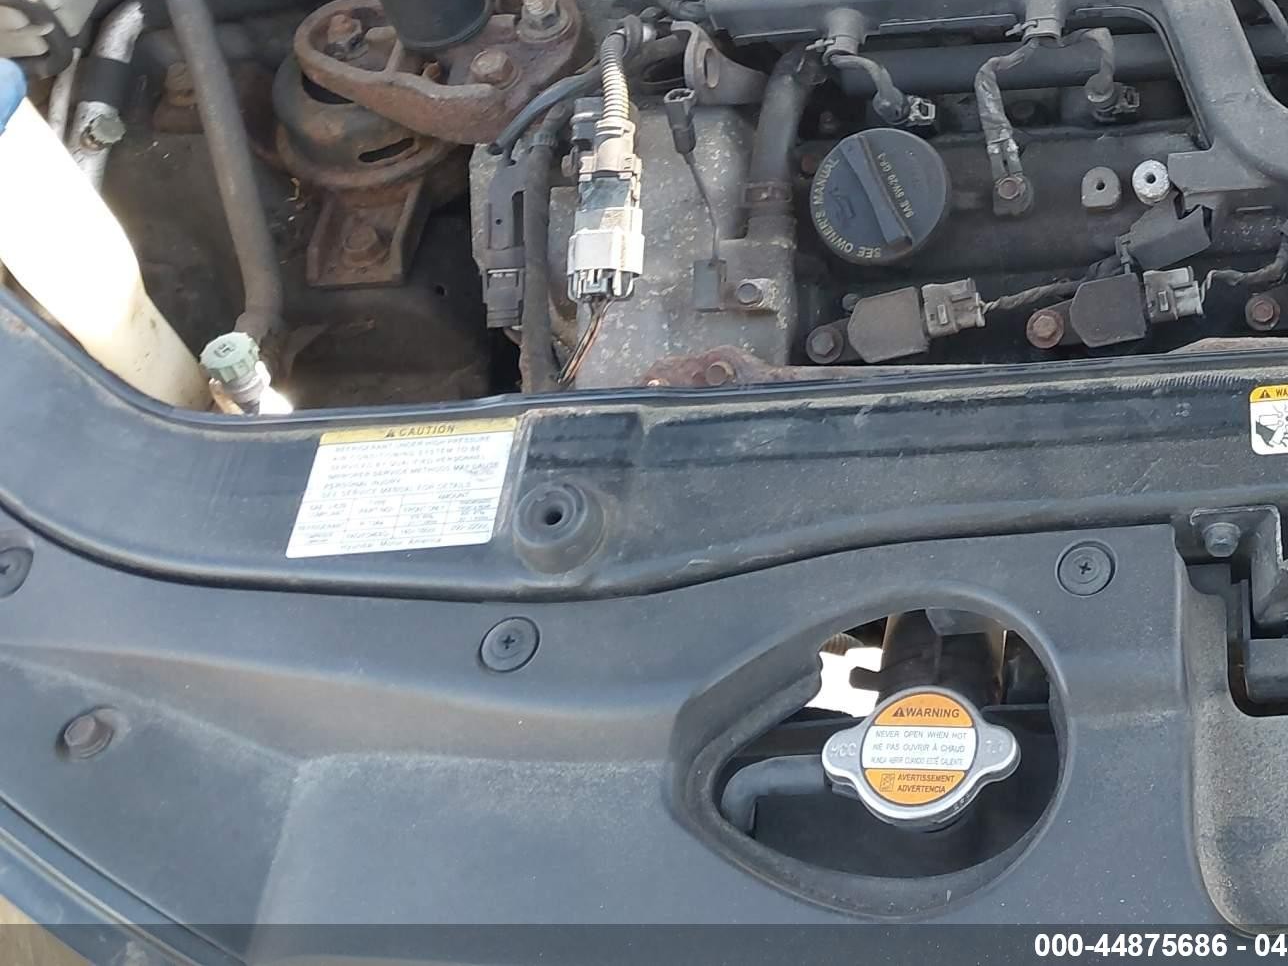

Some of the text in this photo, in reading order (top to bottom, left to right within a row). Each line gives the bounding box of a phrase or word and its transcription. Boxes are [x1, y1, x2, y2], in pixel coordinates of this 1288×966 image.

[812, 158, 881, 259] SEE OWNER'S MANUAL
[900, 198, 914, 219] SAE
[399, 425, 455, 436] CAUTION
[906, 707, 960, 718] WARNING
[876, 730, 967, 740] NEVER OPEN WHEN HOT
[886, 743, 900, 751] PAS
[902, 743, 929, 752] OUVRIR
[941, 744, 965, 753] CHAUD
[897, 774, 955, 783] AVERTISSEMENT
[897, 784, 946, 793] ADVERTENCIA
